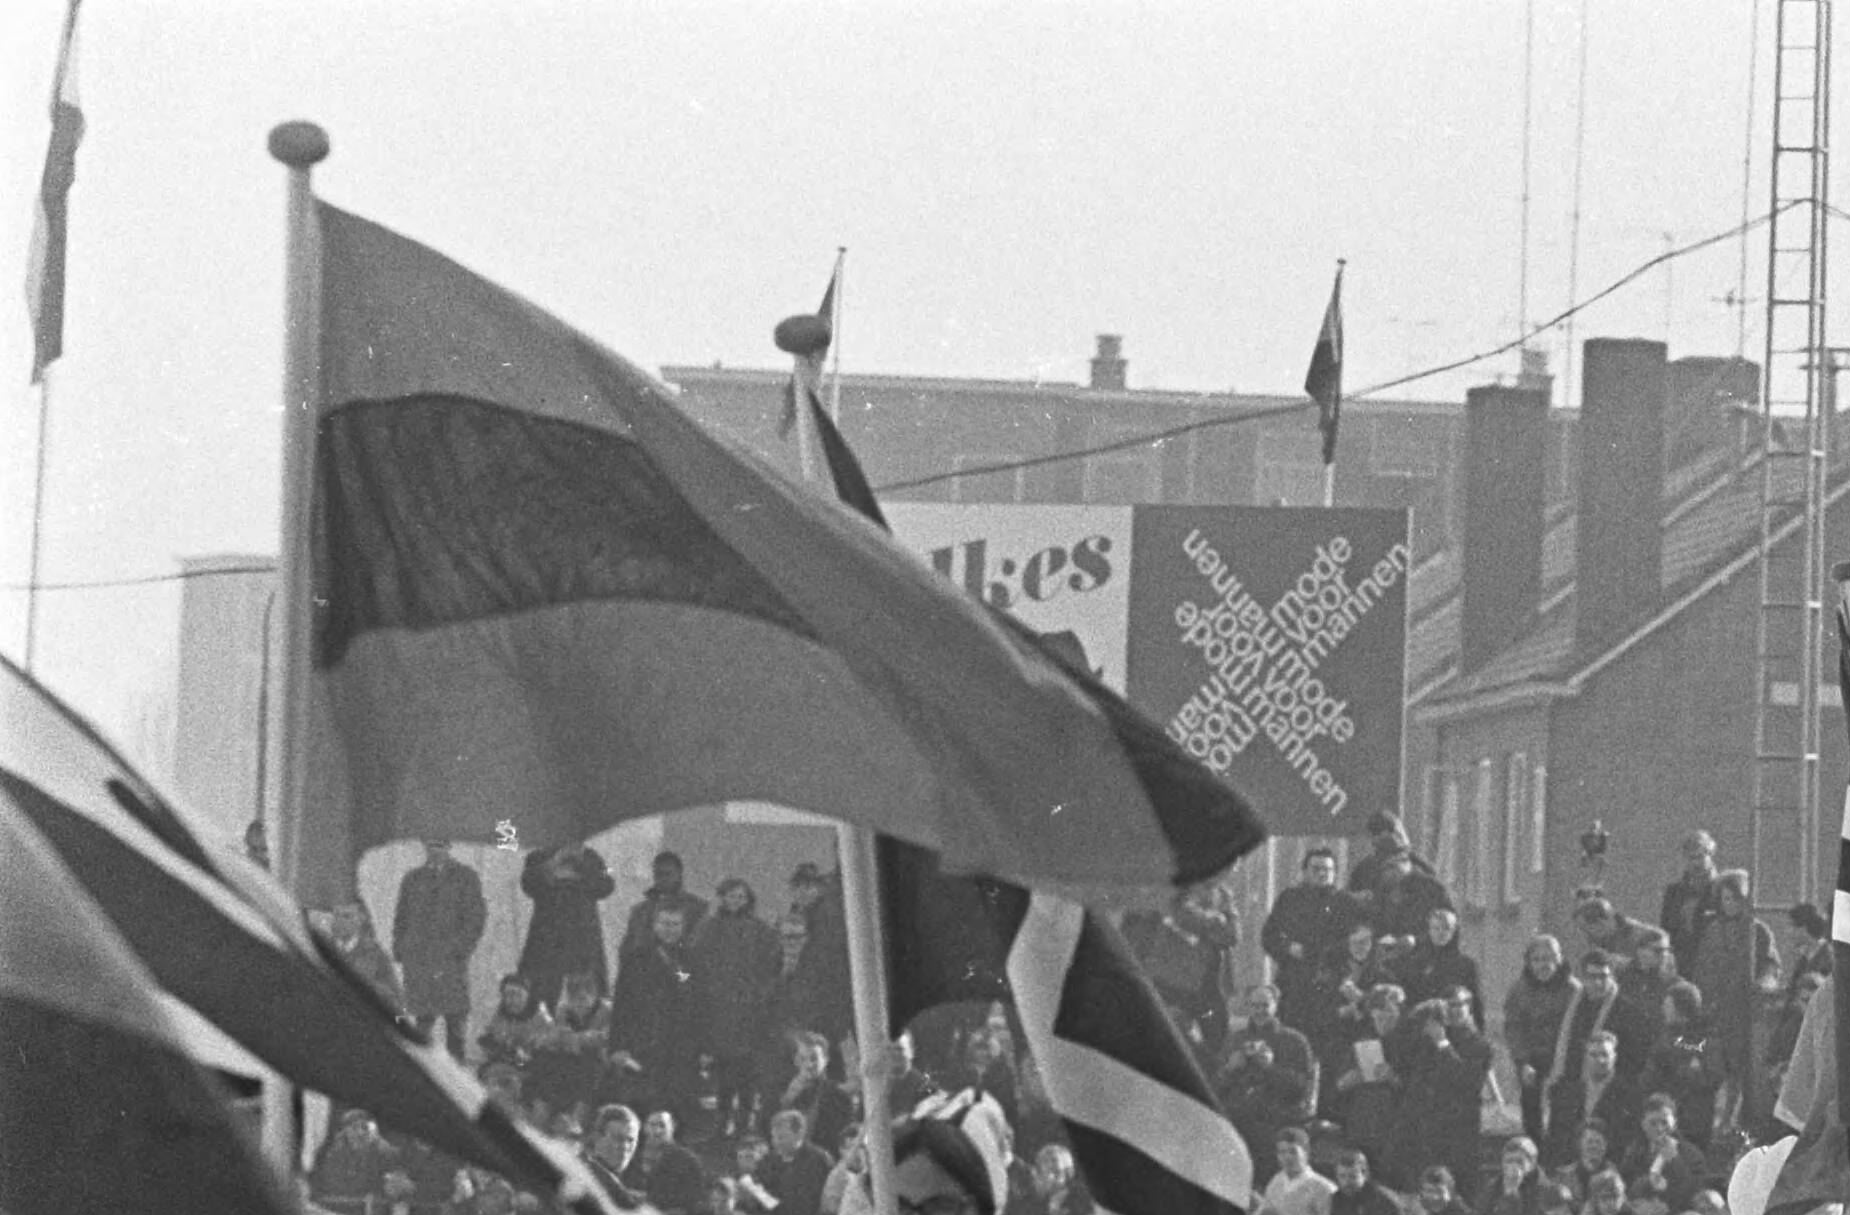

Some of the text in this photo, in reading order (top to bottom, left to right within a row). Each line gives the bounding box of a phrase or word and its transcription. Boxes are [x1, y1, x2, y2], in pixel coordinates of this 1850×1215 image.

[1183, 528, 1286, 657] mannen
[1271, 537, 1351, 629] mode
[1284, 569, 1350, 642] voor
[1302, 544, 1409, 668] mannen
[1175, 601, 1251, 694] mode
[1201, 602, 1264, 677] voor
[1165, 675, 1227, 745] man
[1188, 700, 1244, 757] voo
[1264, 667, 1327, 740] voor
[1277, 650, 1354, 742] mode
[1242, 687, 1347, 815] mannen
